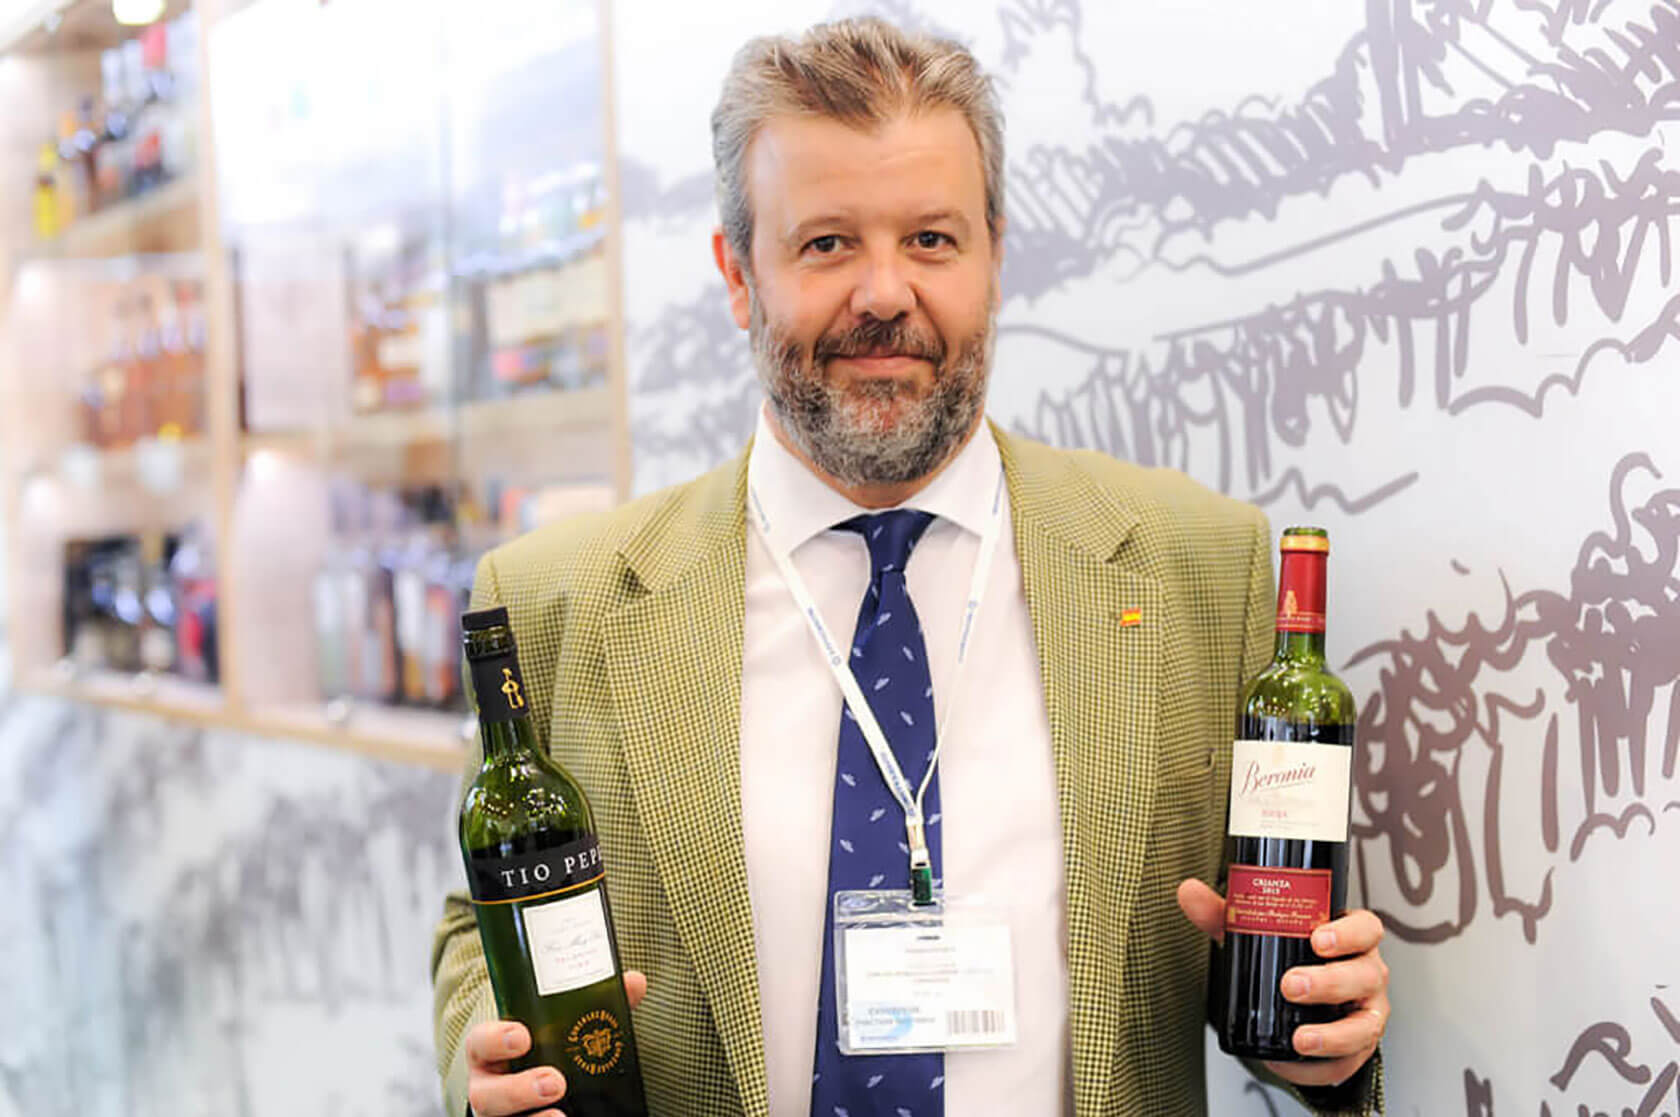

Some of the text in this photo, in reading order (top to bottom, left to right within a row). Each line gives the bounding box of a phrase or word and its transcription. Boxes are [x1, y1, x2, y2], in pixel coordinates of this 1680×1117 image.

[1239, 760, 1316, 797] Beronia
[501, 863, 551, 888] TIO
[1251, 878, 1291, 889] CRIANZA
